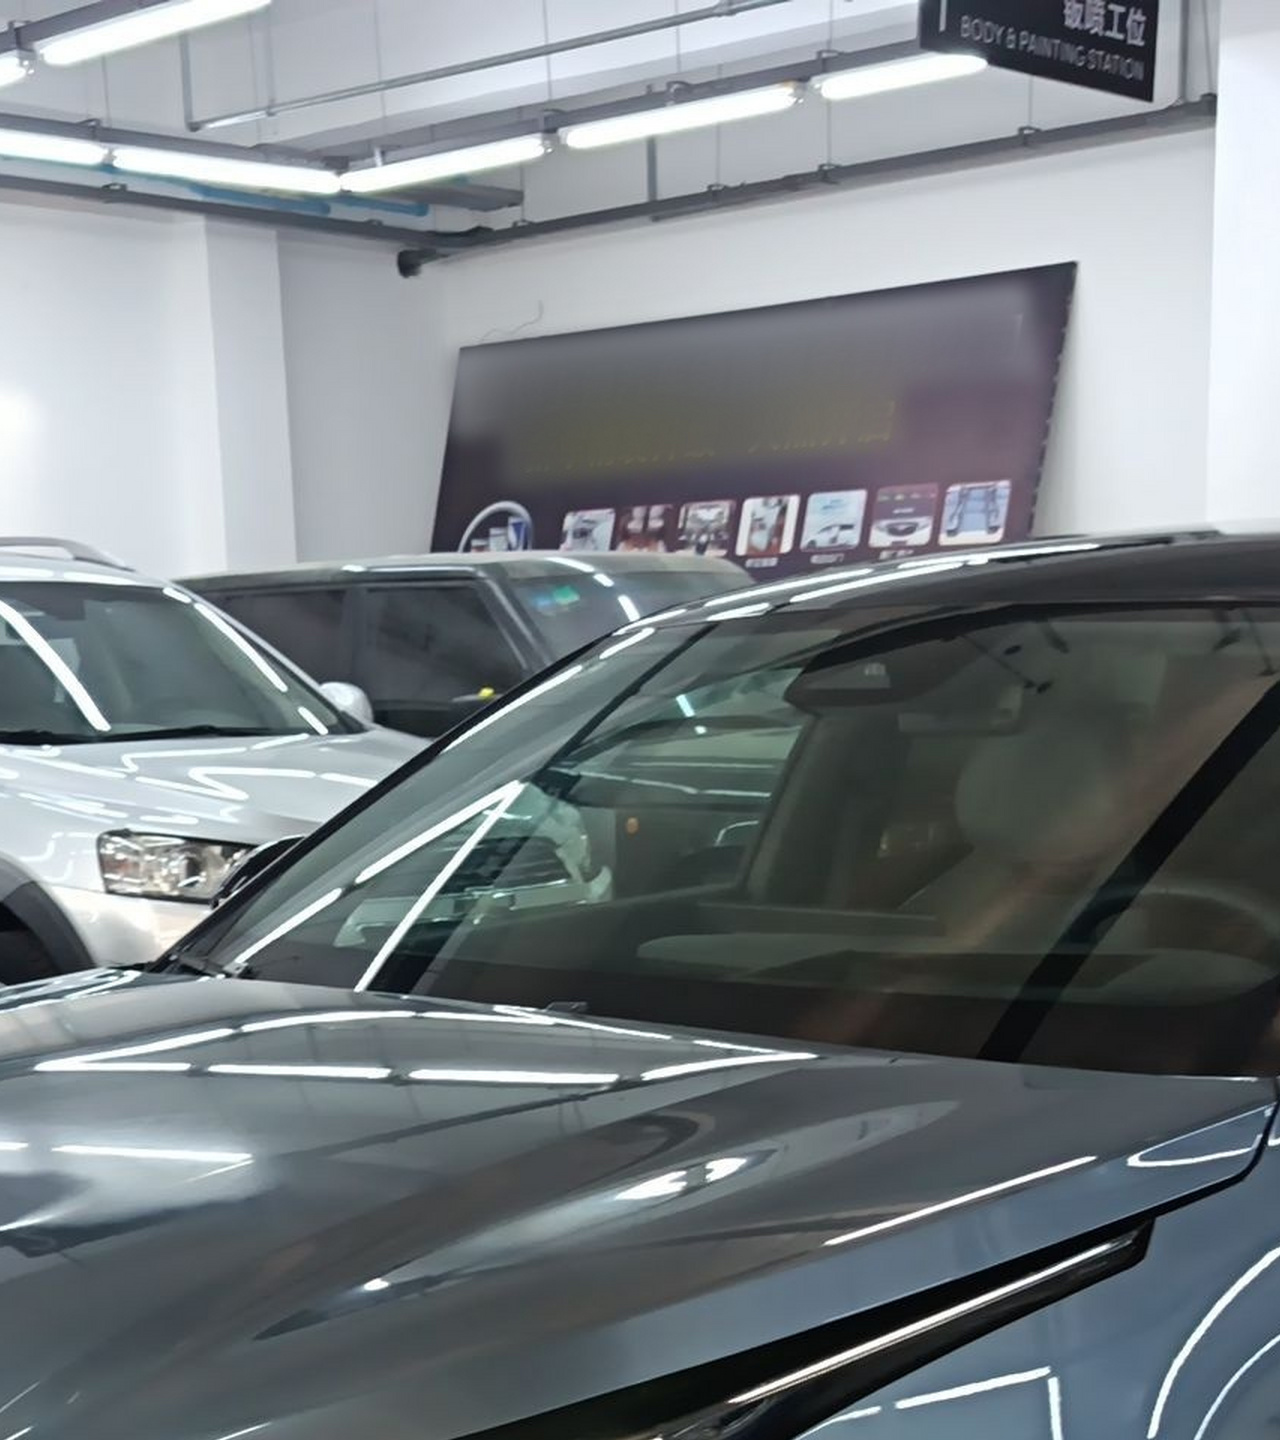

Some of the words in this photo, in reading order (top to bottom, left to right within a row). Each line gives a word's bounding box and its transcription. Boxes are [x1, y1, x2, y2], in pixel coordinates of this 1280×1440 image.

[960, 15, 1004, 45] BODY
[1005, 28, 1016, 49] &
[1018, 31, 1085, 67] PAINTING
[1086, 48, 1144, 81] STATION
